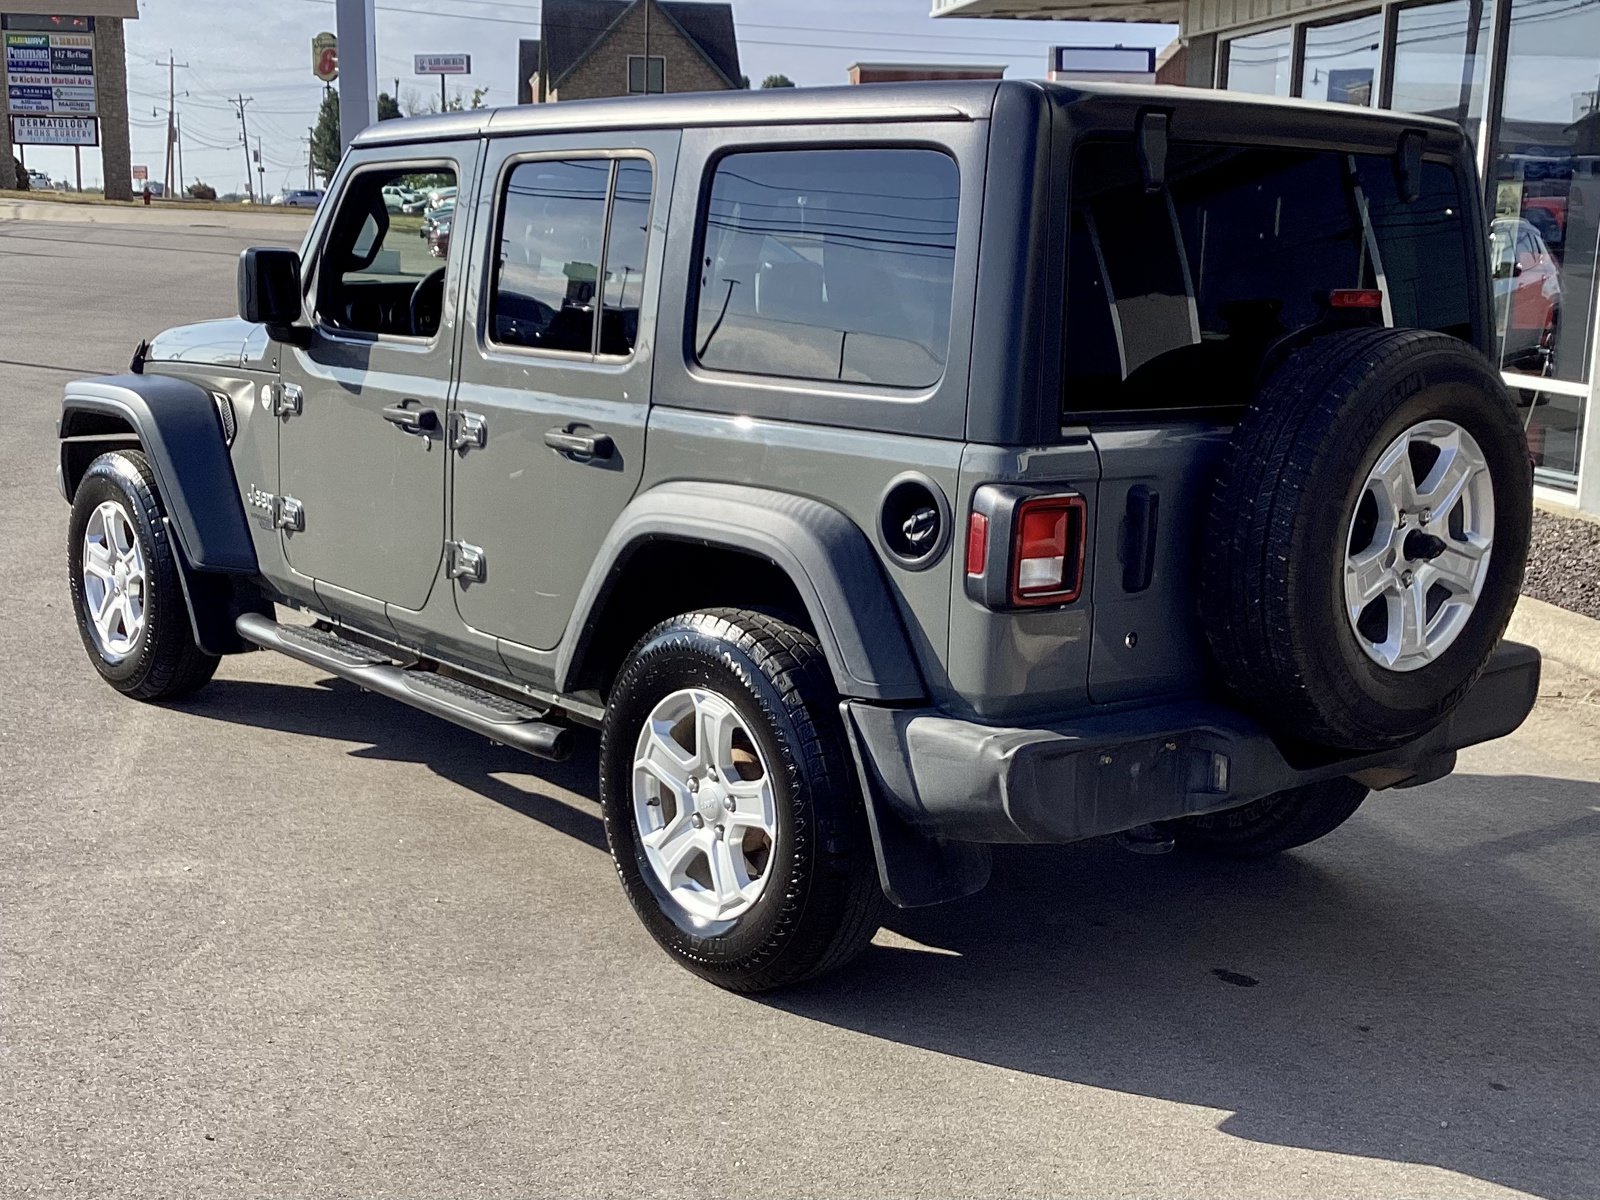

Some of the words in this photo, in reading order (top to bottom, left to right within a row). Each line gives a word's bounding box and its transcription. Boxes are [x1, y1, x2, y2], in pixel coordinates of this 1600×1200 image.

[9, 37, 45, 45] SUBWAY
[8, 47, 48, 59] Penmac
[19, 75, 42, 83] Kickin'
[51, 76, 76, 84] Martial
[78, 77, 92, 85] Arts
[20, 119, 89, 128] DERMATOLOGY
[27, 129, 51, 137] MOHS
[54, 129, 92, 137] SURGERY
[246, 483, 274, 513] Jeep
